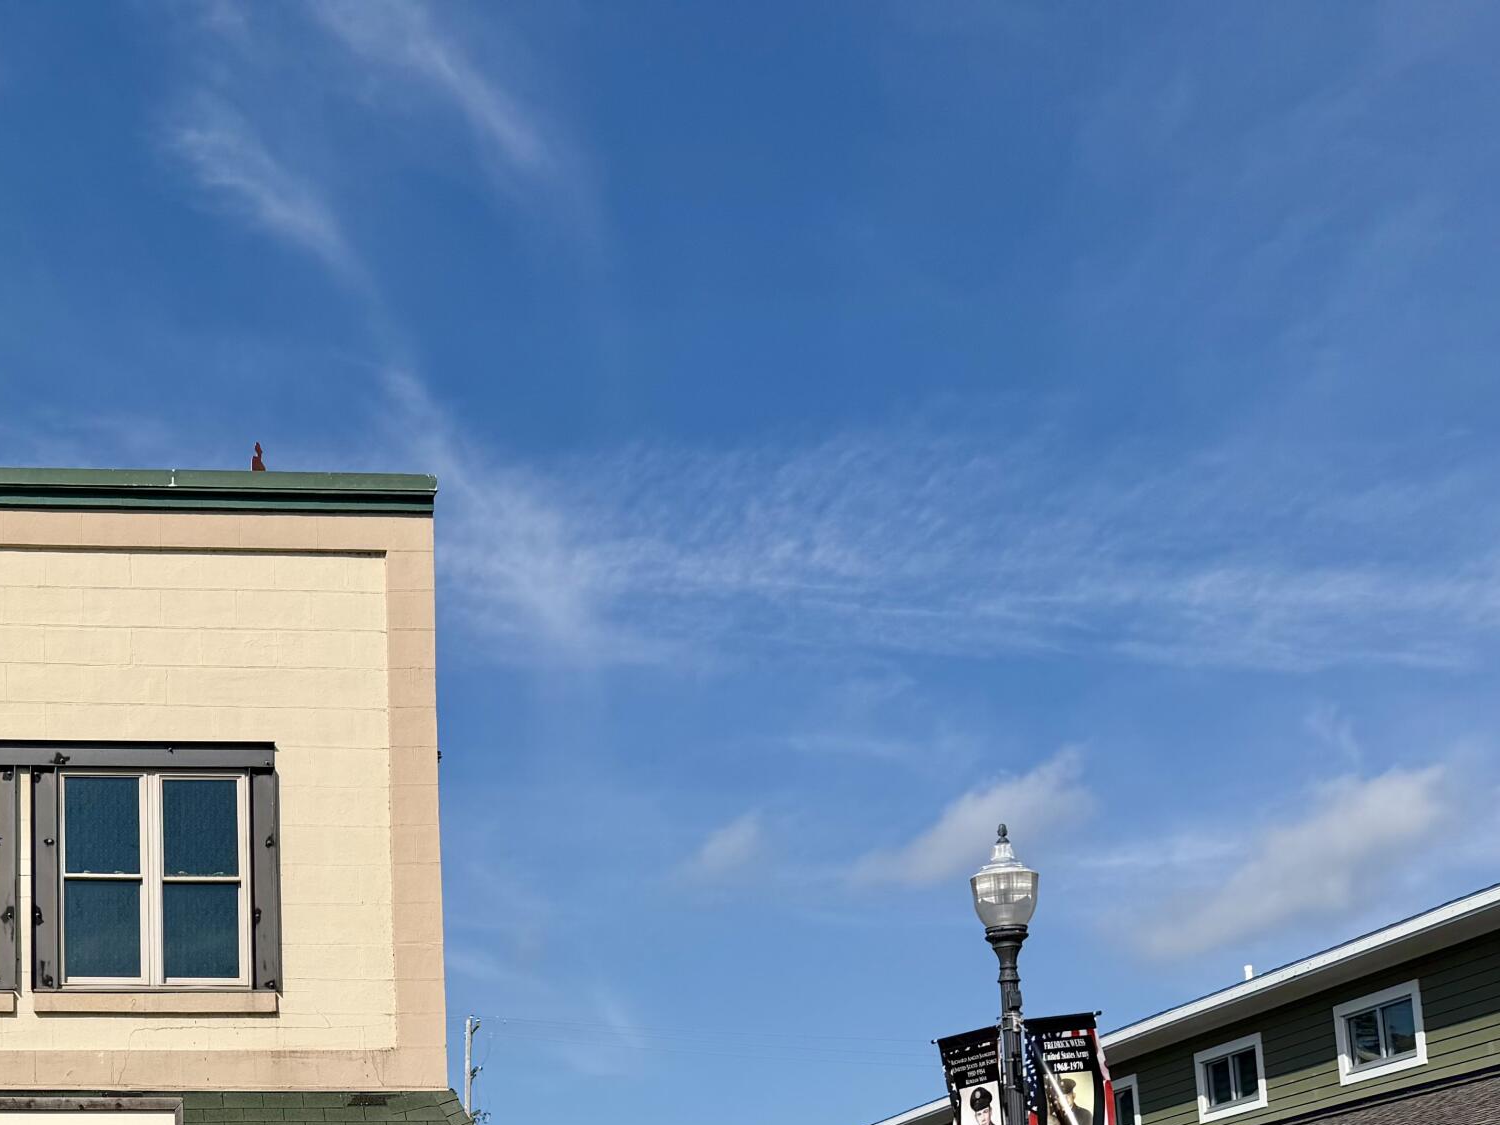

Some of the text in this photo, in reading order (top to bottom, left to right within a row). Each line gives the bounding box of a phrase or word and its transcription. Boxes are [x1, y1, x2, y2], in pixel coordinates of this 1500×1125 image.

[1042, 1050, 1089, 1061] United States Army
